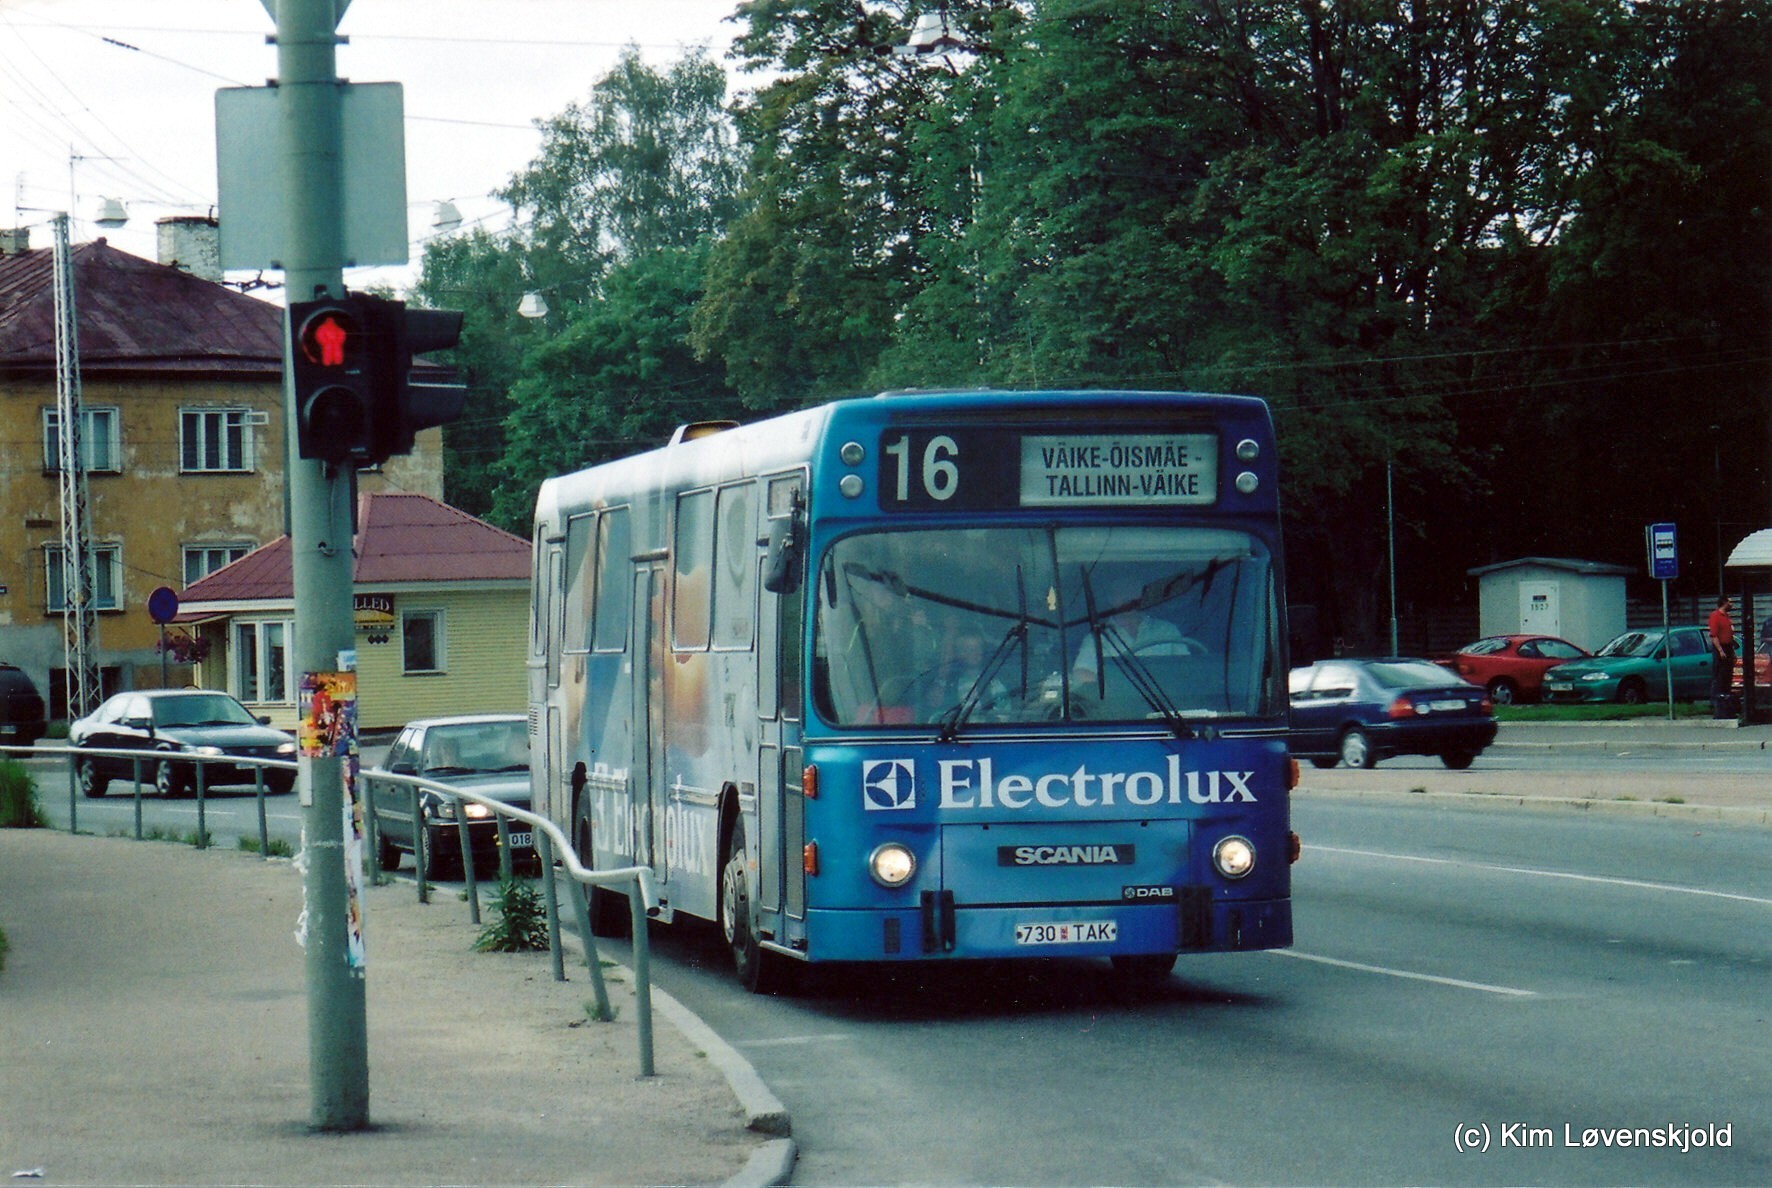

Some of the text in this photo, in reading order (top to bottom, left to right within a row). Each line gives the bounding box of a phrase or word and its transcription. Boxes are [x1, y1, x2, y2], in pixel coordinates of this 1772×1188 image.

[886, 435, 959, 501] 16
[1045, 469, 1200, 497] TALLINN-VÄIKE
[938, 754, 1258, 809] Electrolux
[1014, 846, 1119, 865] SCANIA
[1136, 887, 1174, 897] DAB
[1024, 923, 1110, 942] 730 TAK
